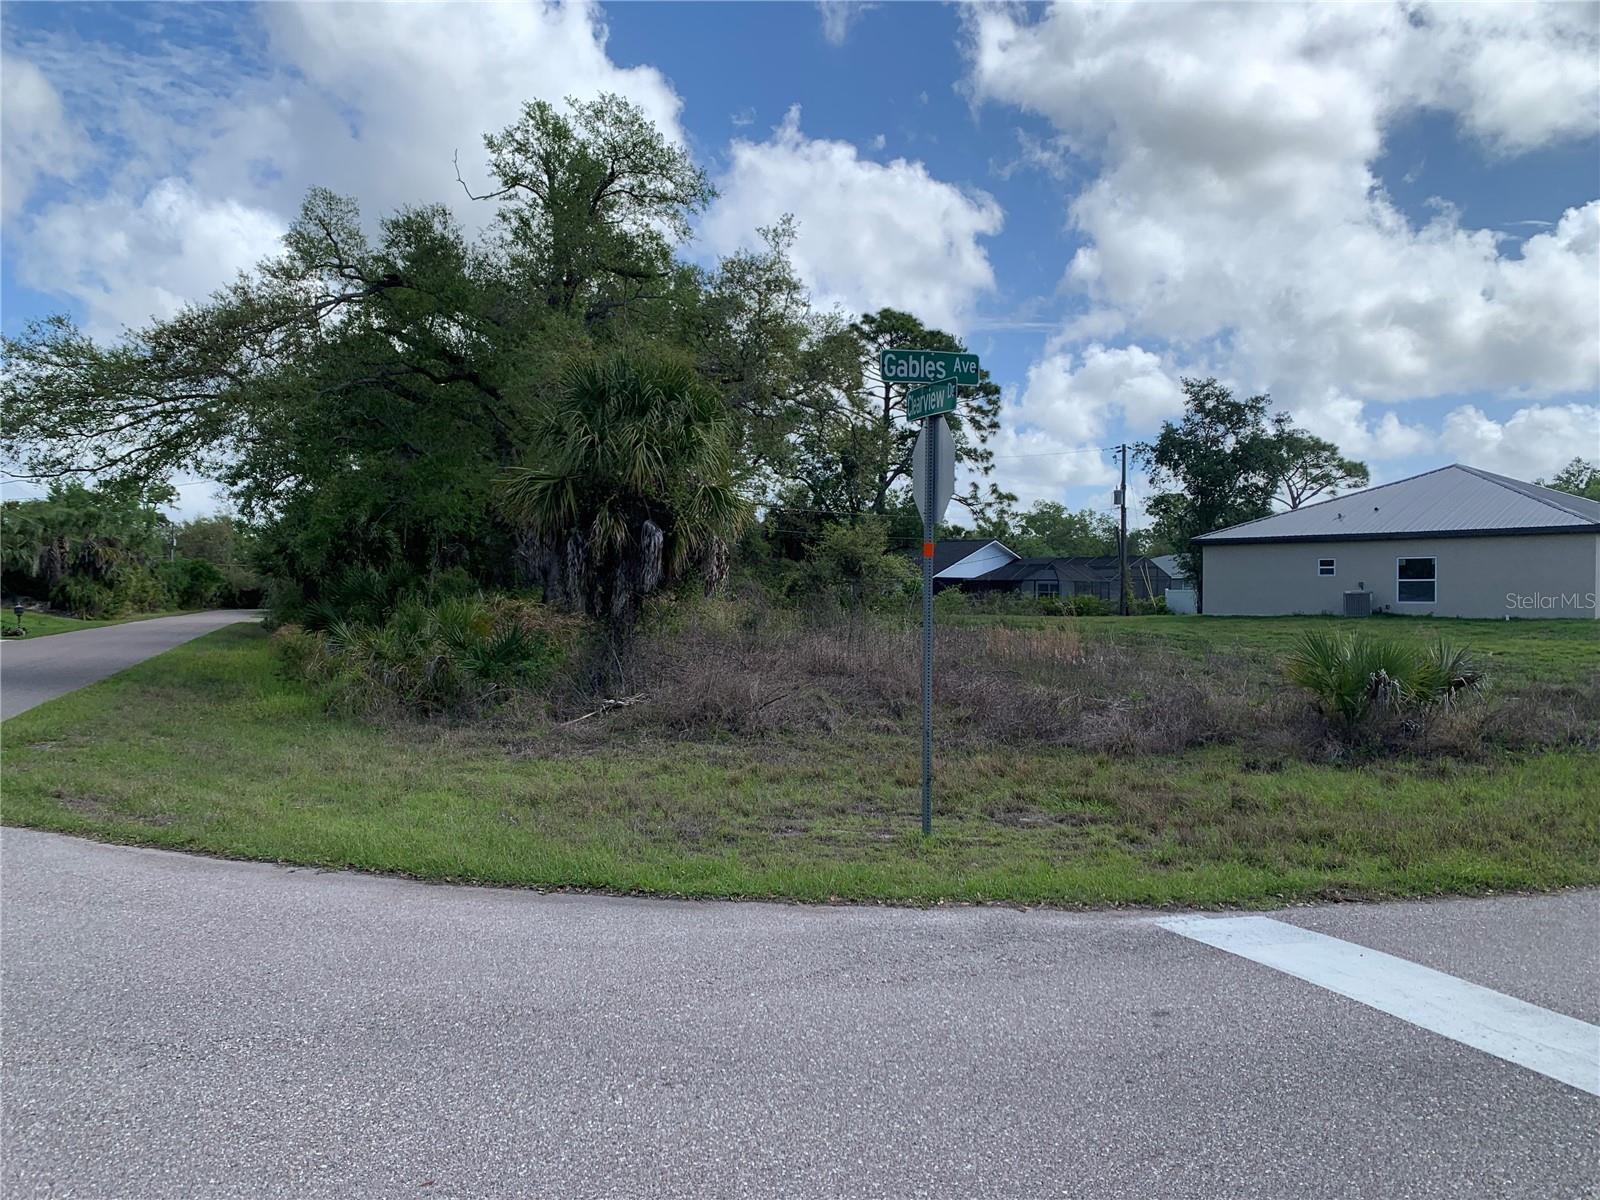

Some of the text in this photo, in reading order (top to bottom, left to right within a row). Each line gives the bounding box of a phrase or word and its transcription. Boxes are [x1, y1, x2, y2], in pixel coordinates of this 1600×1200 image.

[883, 353, 977, 379] Gables Ave
[907, 382, 955, 417] Clearview Dr
